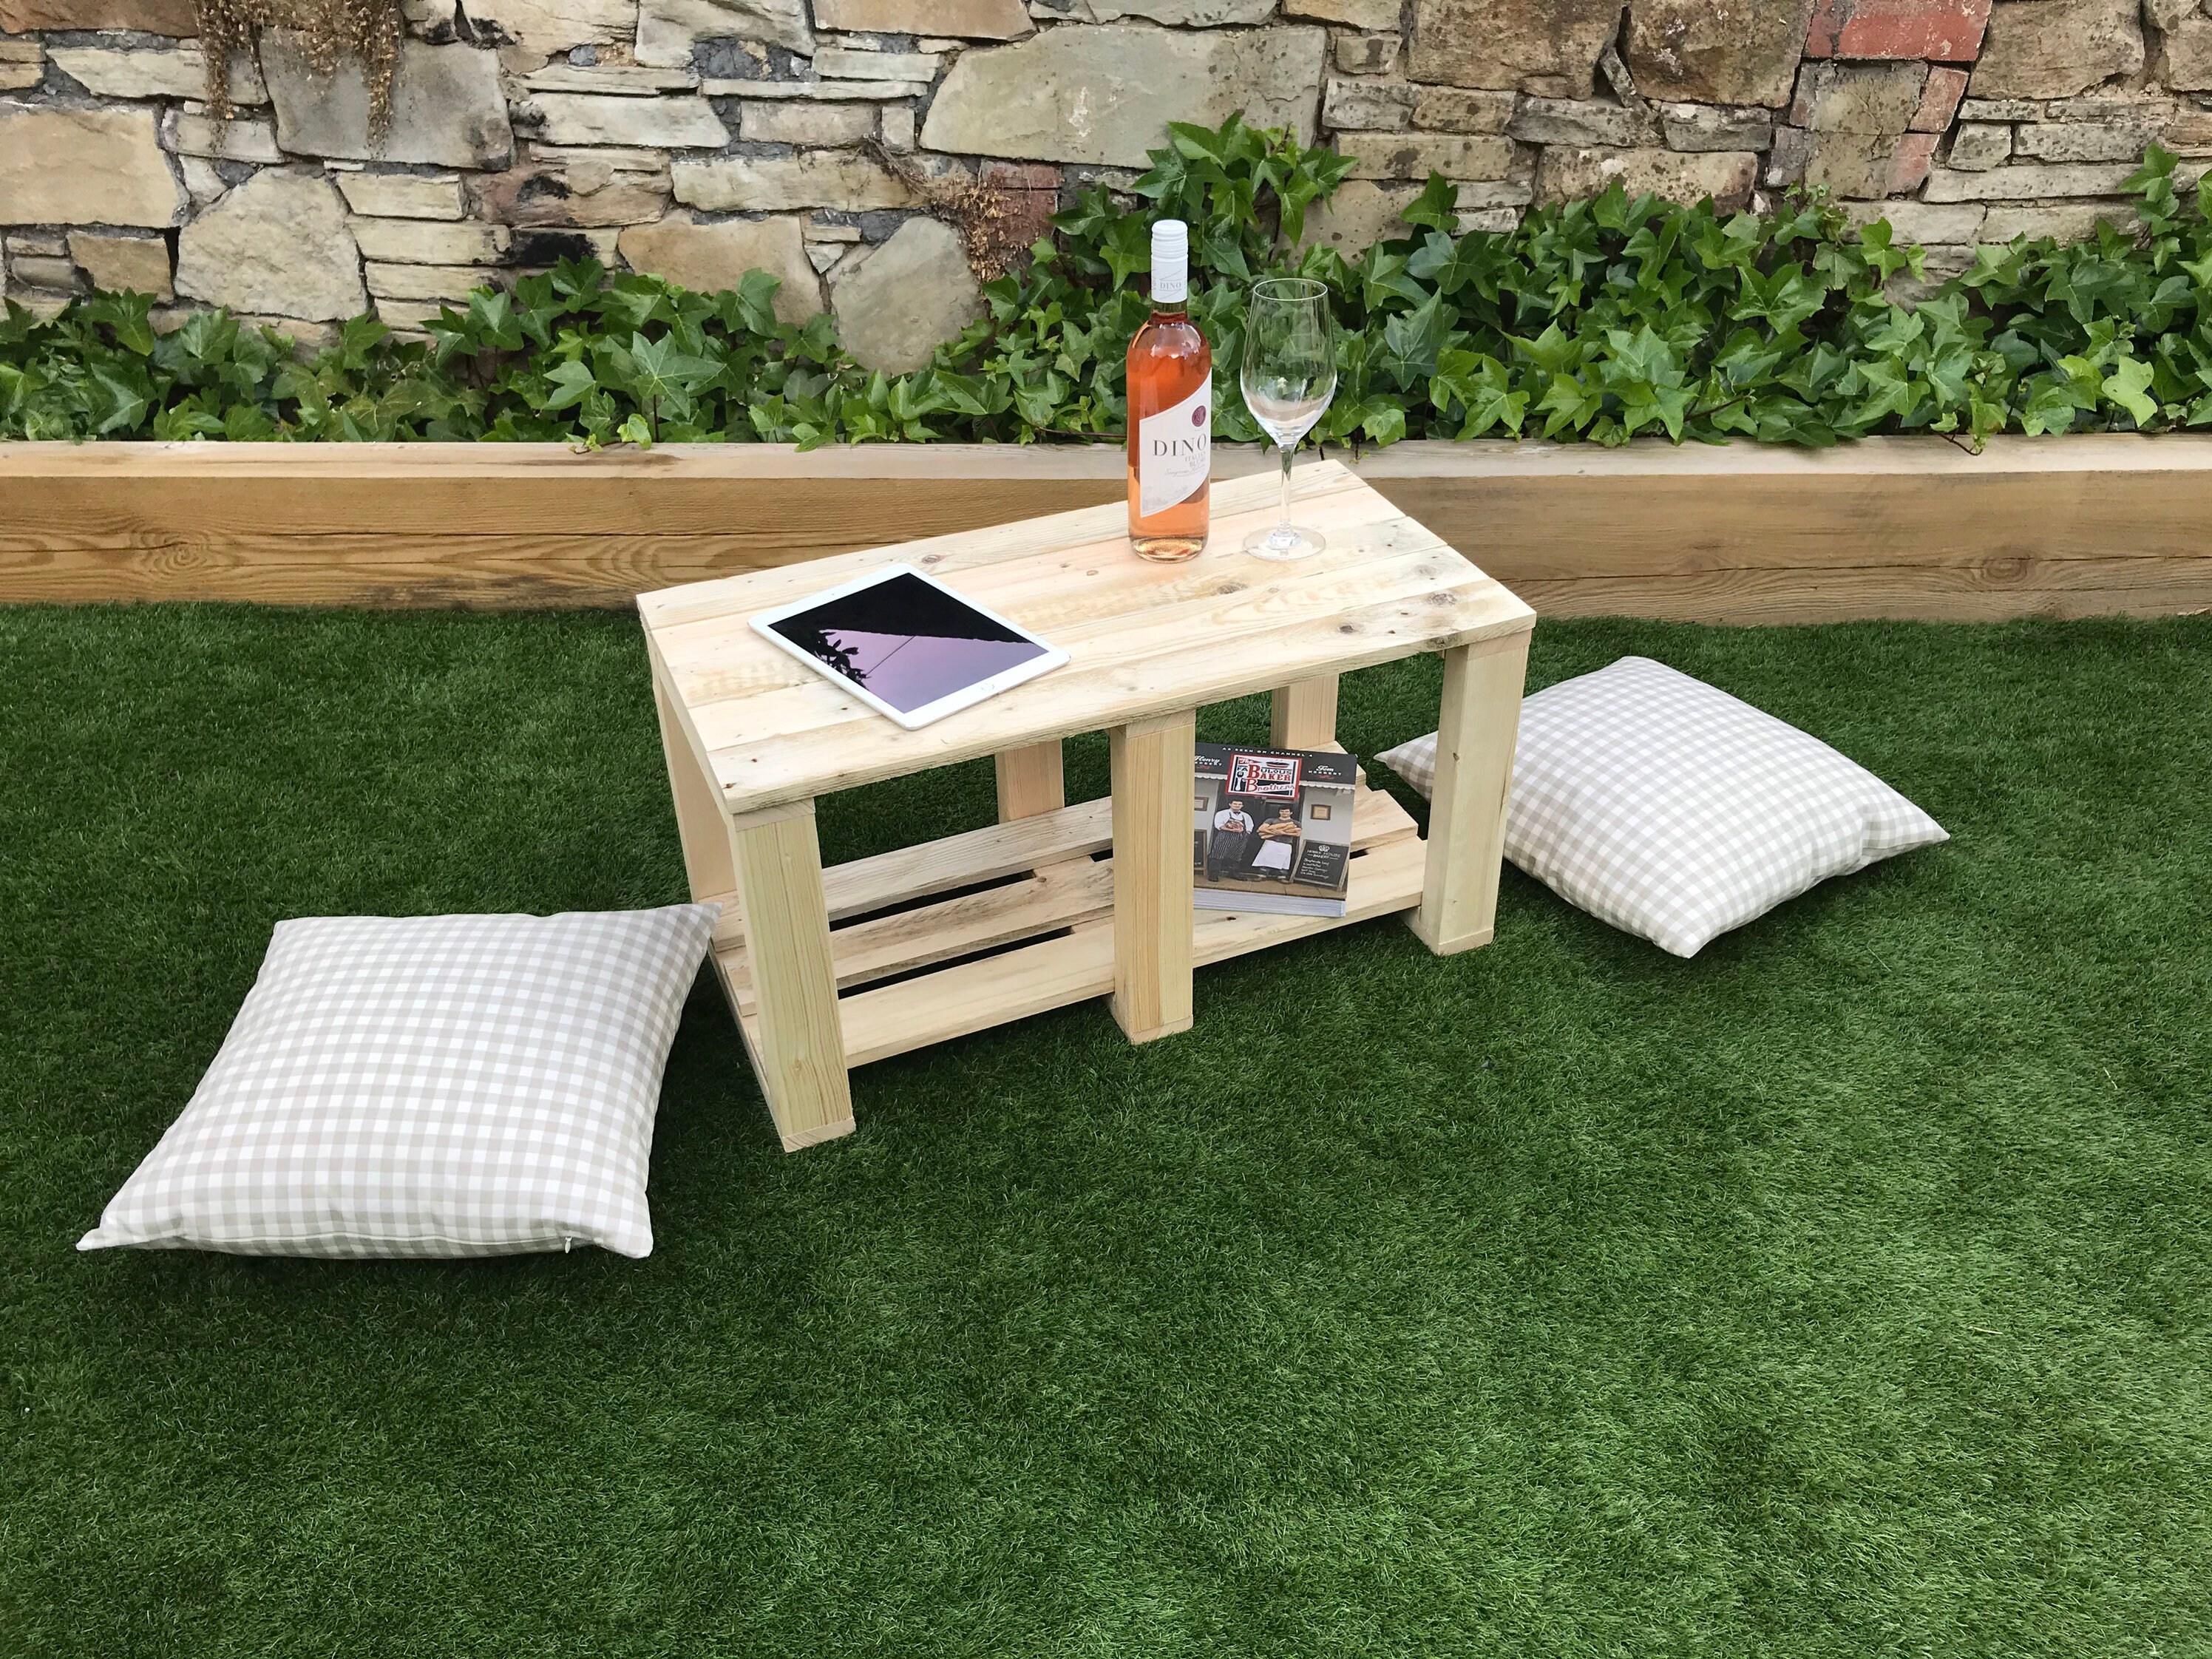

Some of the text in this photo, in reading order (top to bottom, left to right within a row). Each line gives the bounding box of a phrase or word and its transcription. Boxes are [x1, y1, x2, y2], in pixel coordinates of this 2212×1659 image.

[1153, 433, 1207, 456] DINO
[1195, 755, 1221, 763] Henry
[1246, 764, 1291, 781] BAKER
[1243, 778, 1295, 793] Brothers
